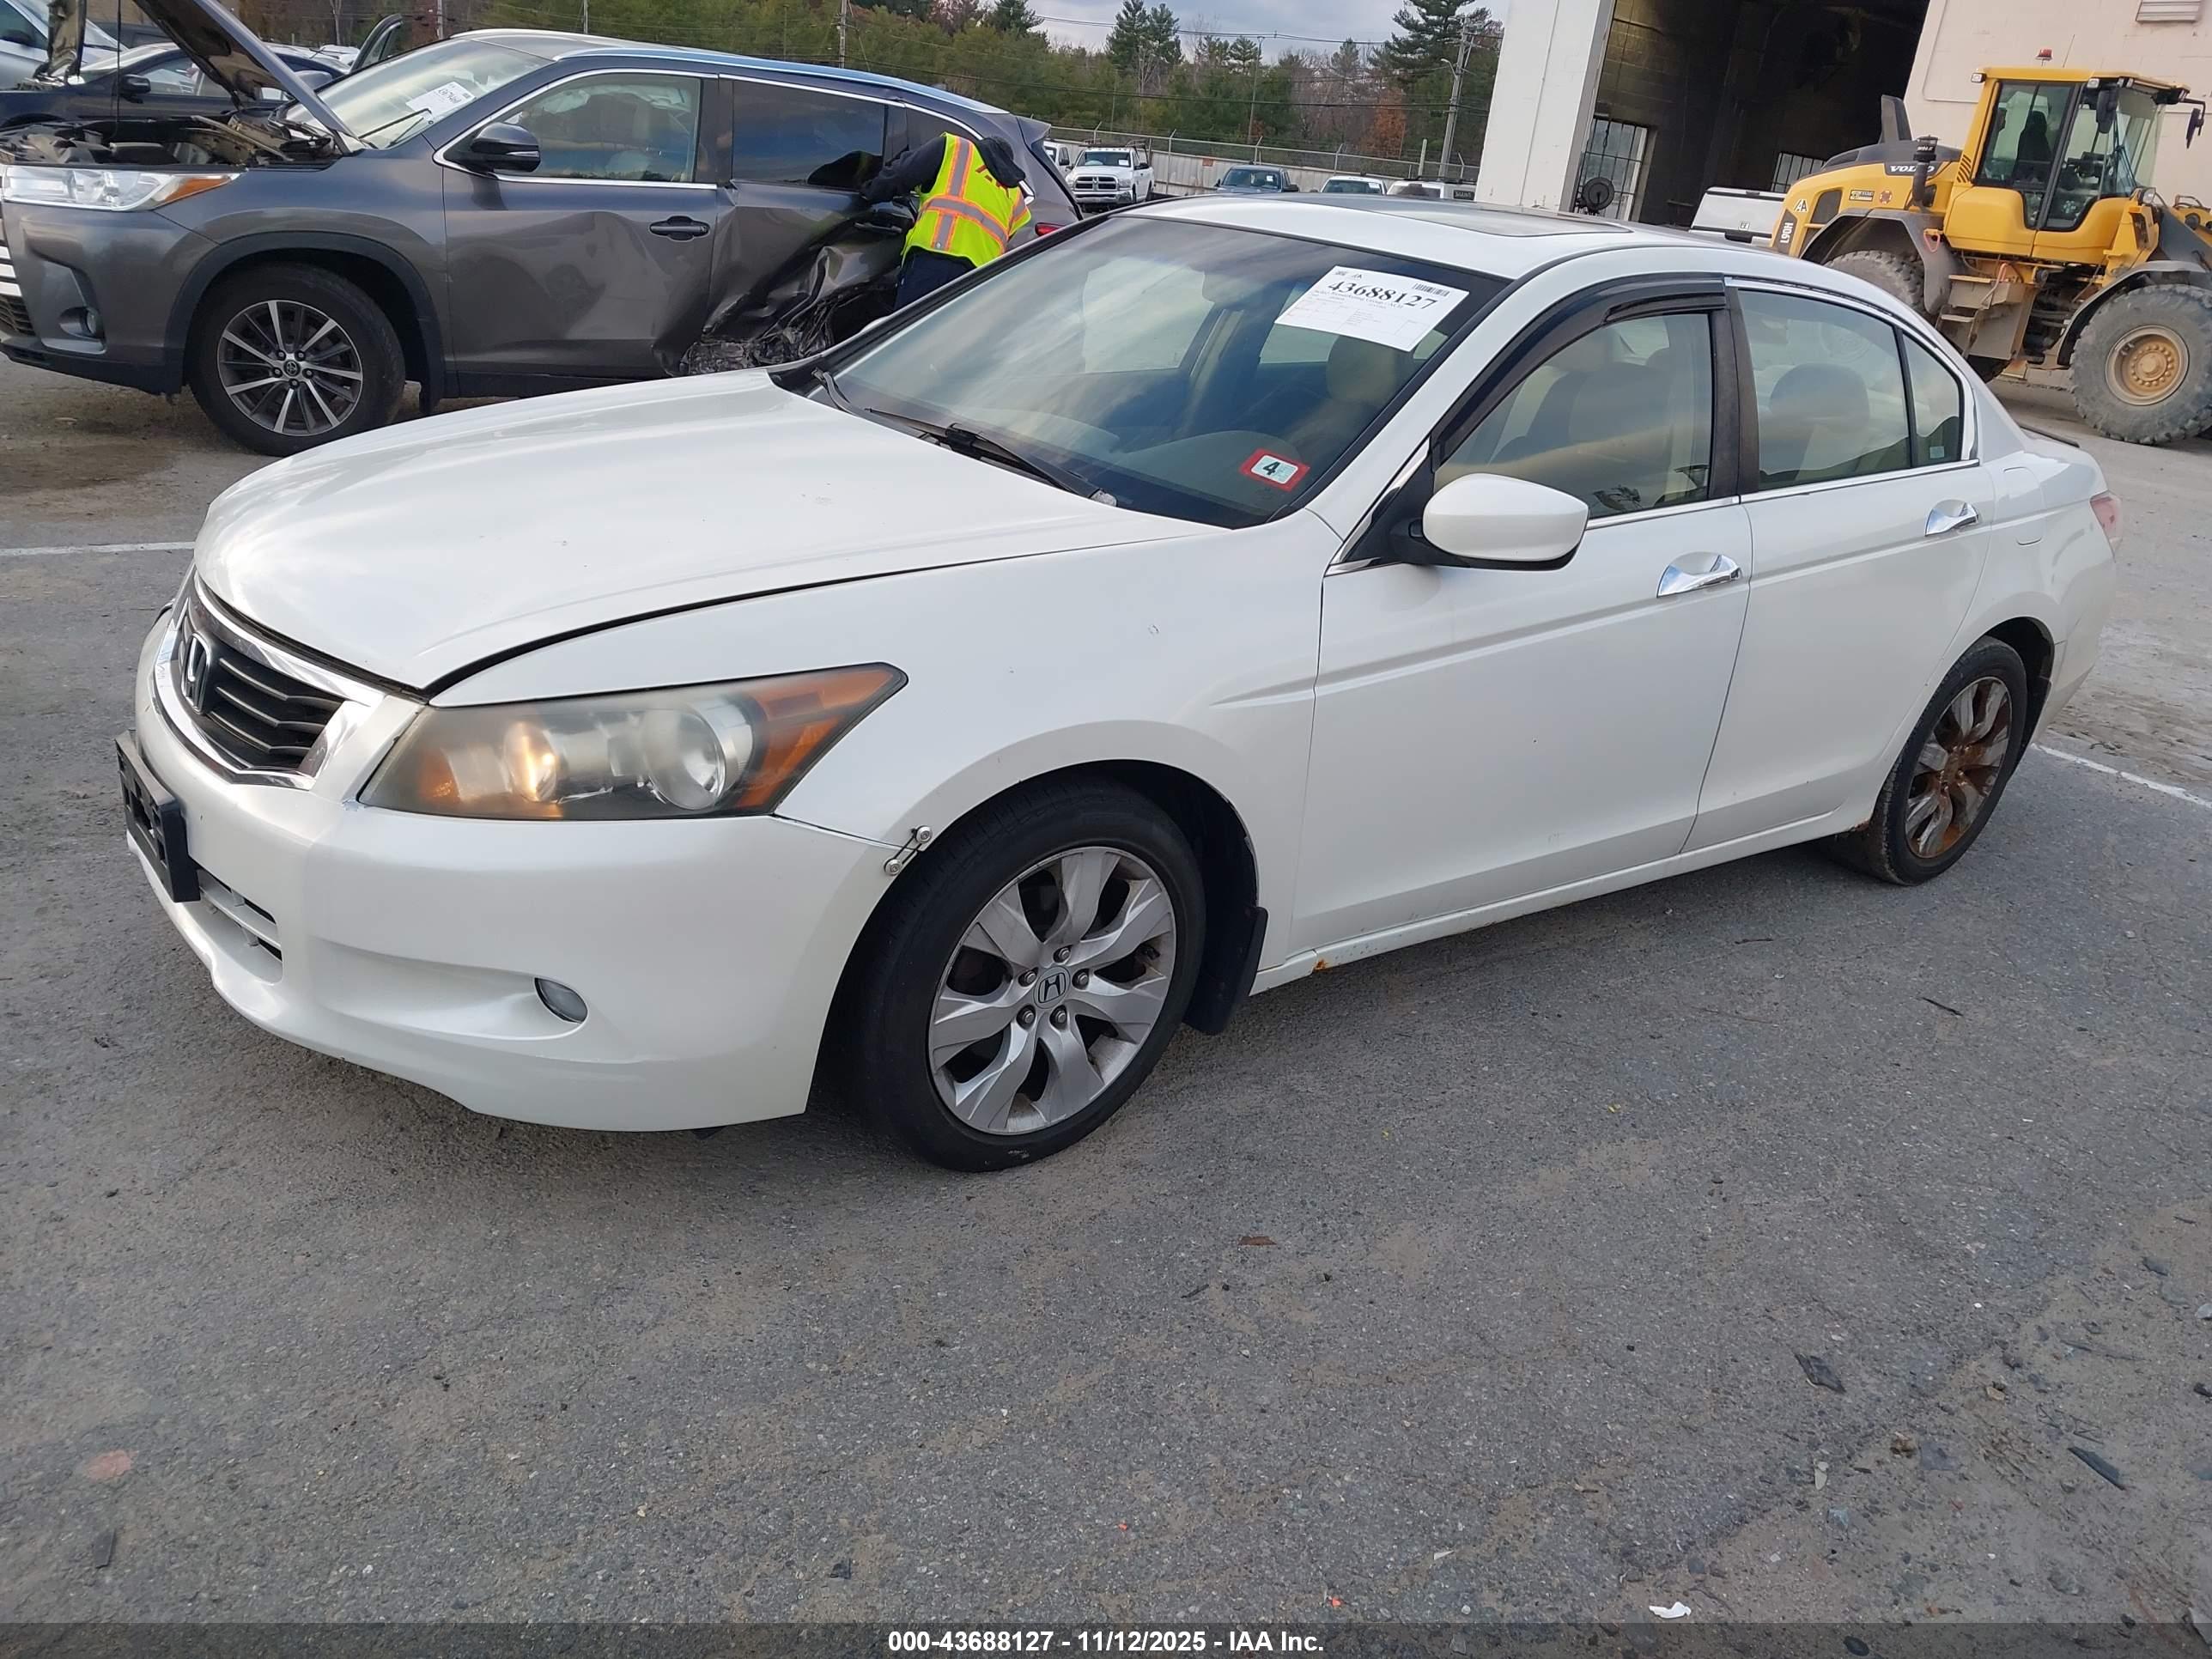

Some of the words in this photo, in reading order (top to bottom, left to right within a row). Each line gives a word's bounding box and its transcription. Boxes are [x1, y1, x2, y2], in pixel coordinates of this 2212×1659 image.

[1779, 222, 1794, 244] L90H
[1328, 280, 1438, 310] 43688127
[1262, 461, 1281, 476] 4
